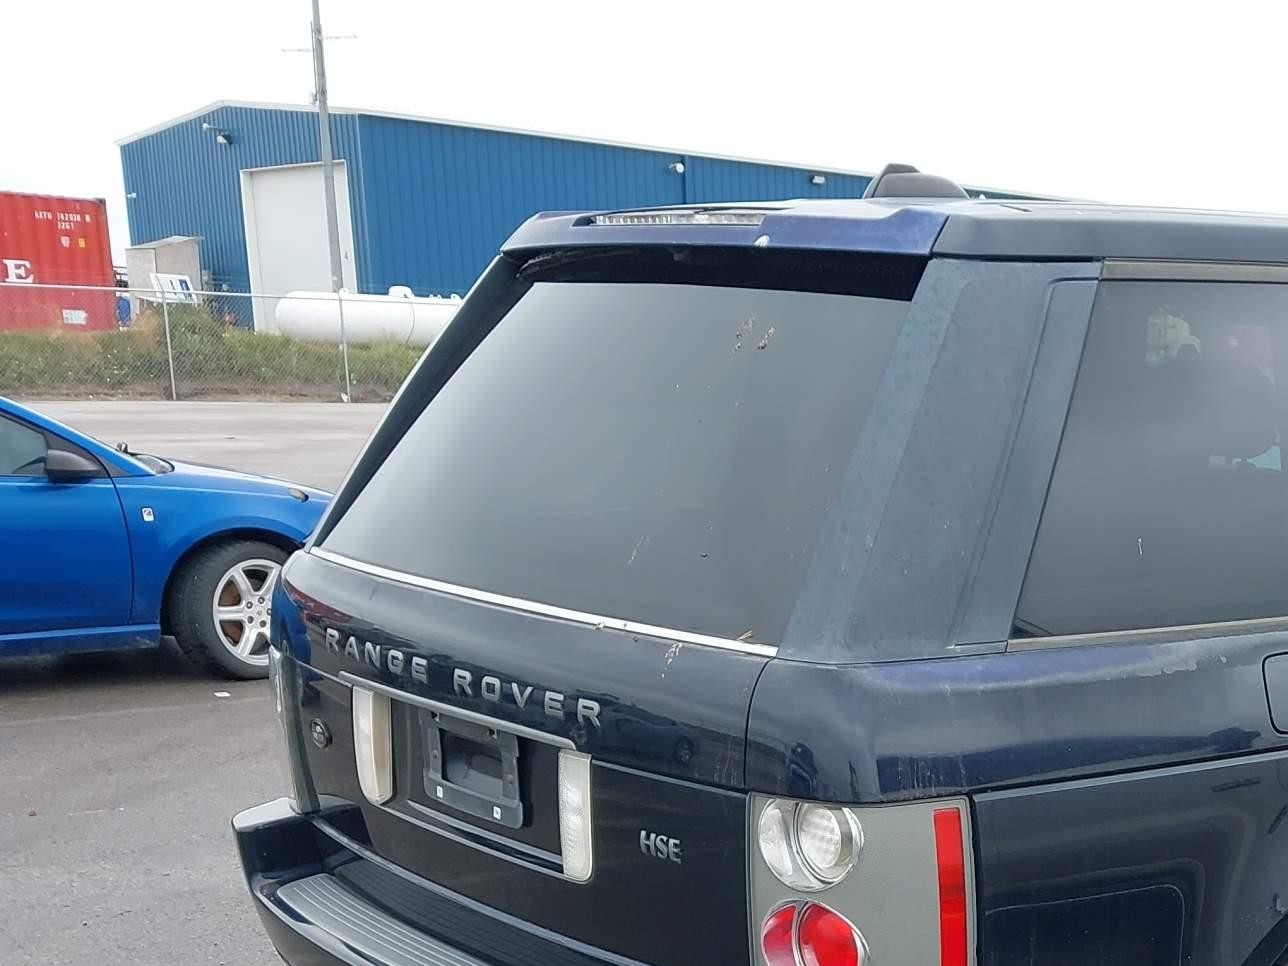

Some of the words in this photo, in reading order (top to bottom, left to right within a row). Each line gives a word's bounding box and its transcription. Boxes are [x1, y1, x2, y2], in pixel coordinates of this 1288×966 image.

[325, 627, 428, 684] RANGE
[453, 668, 601, 729] ROVER
[640, 830, 682, 864] HSE
